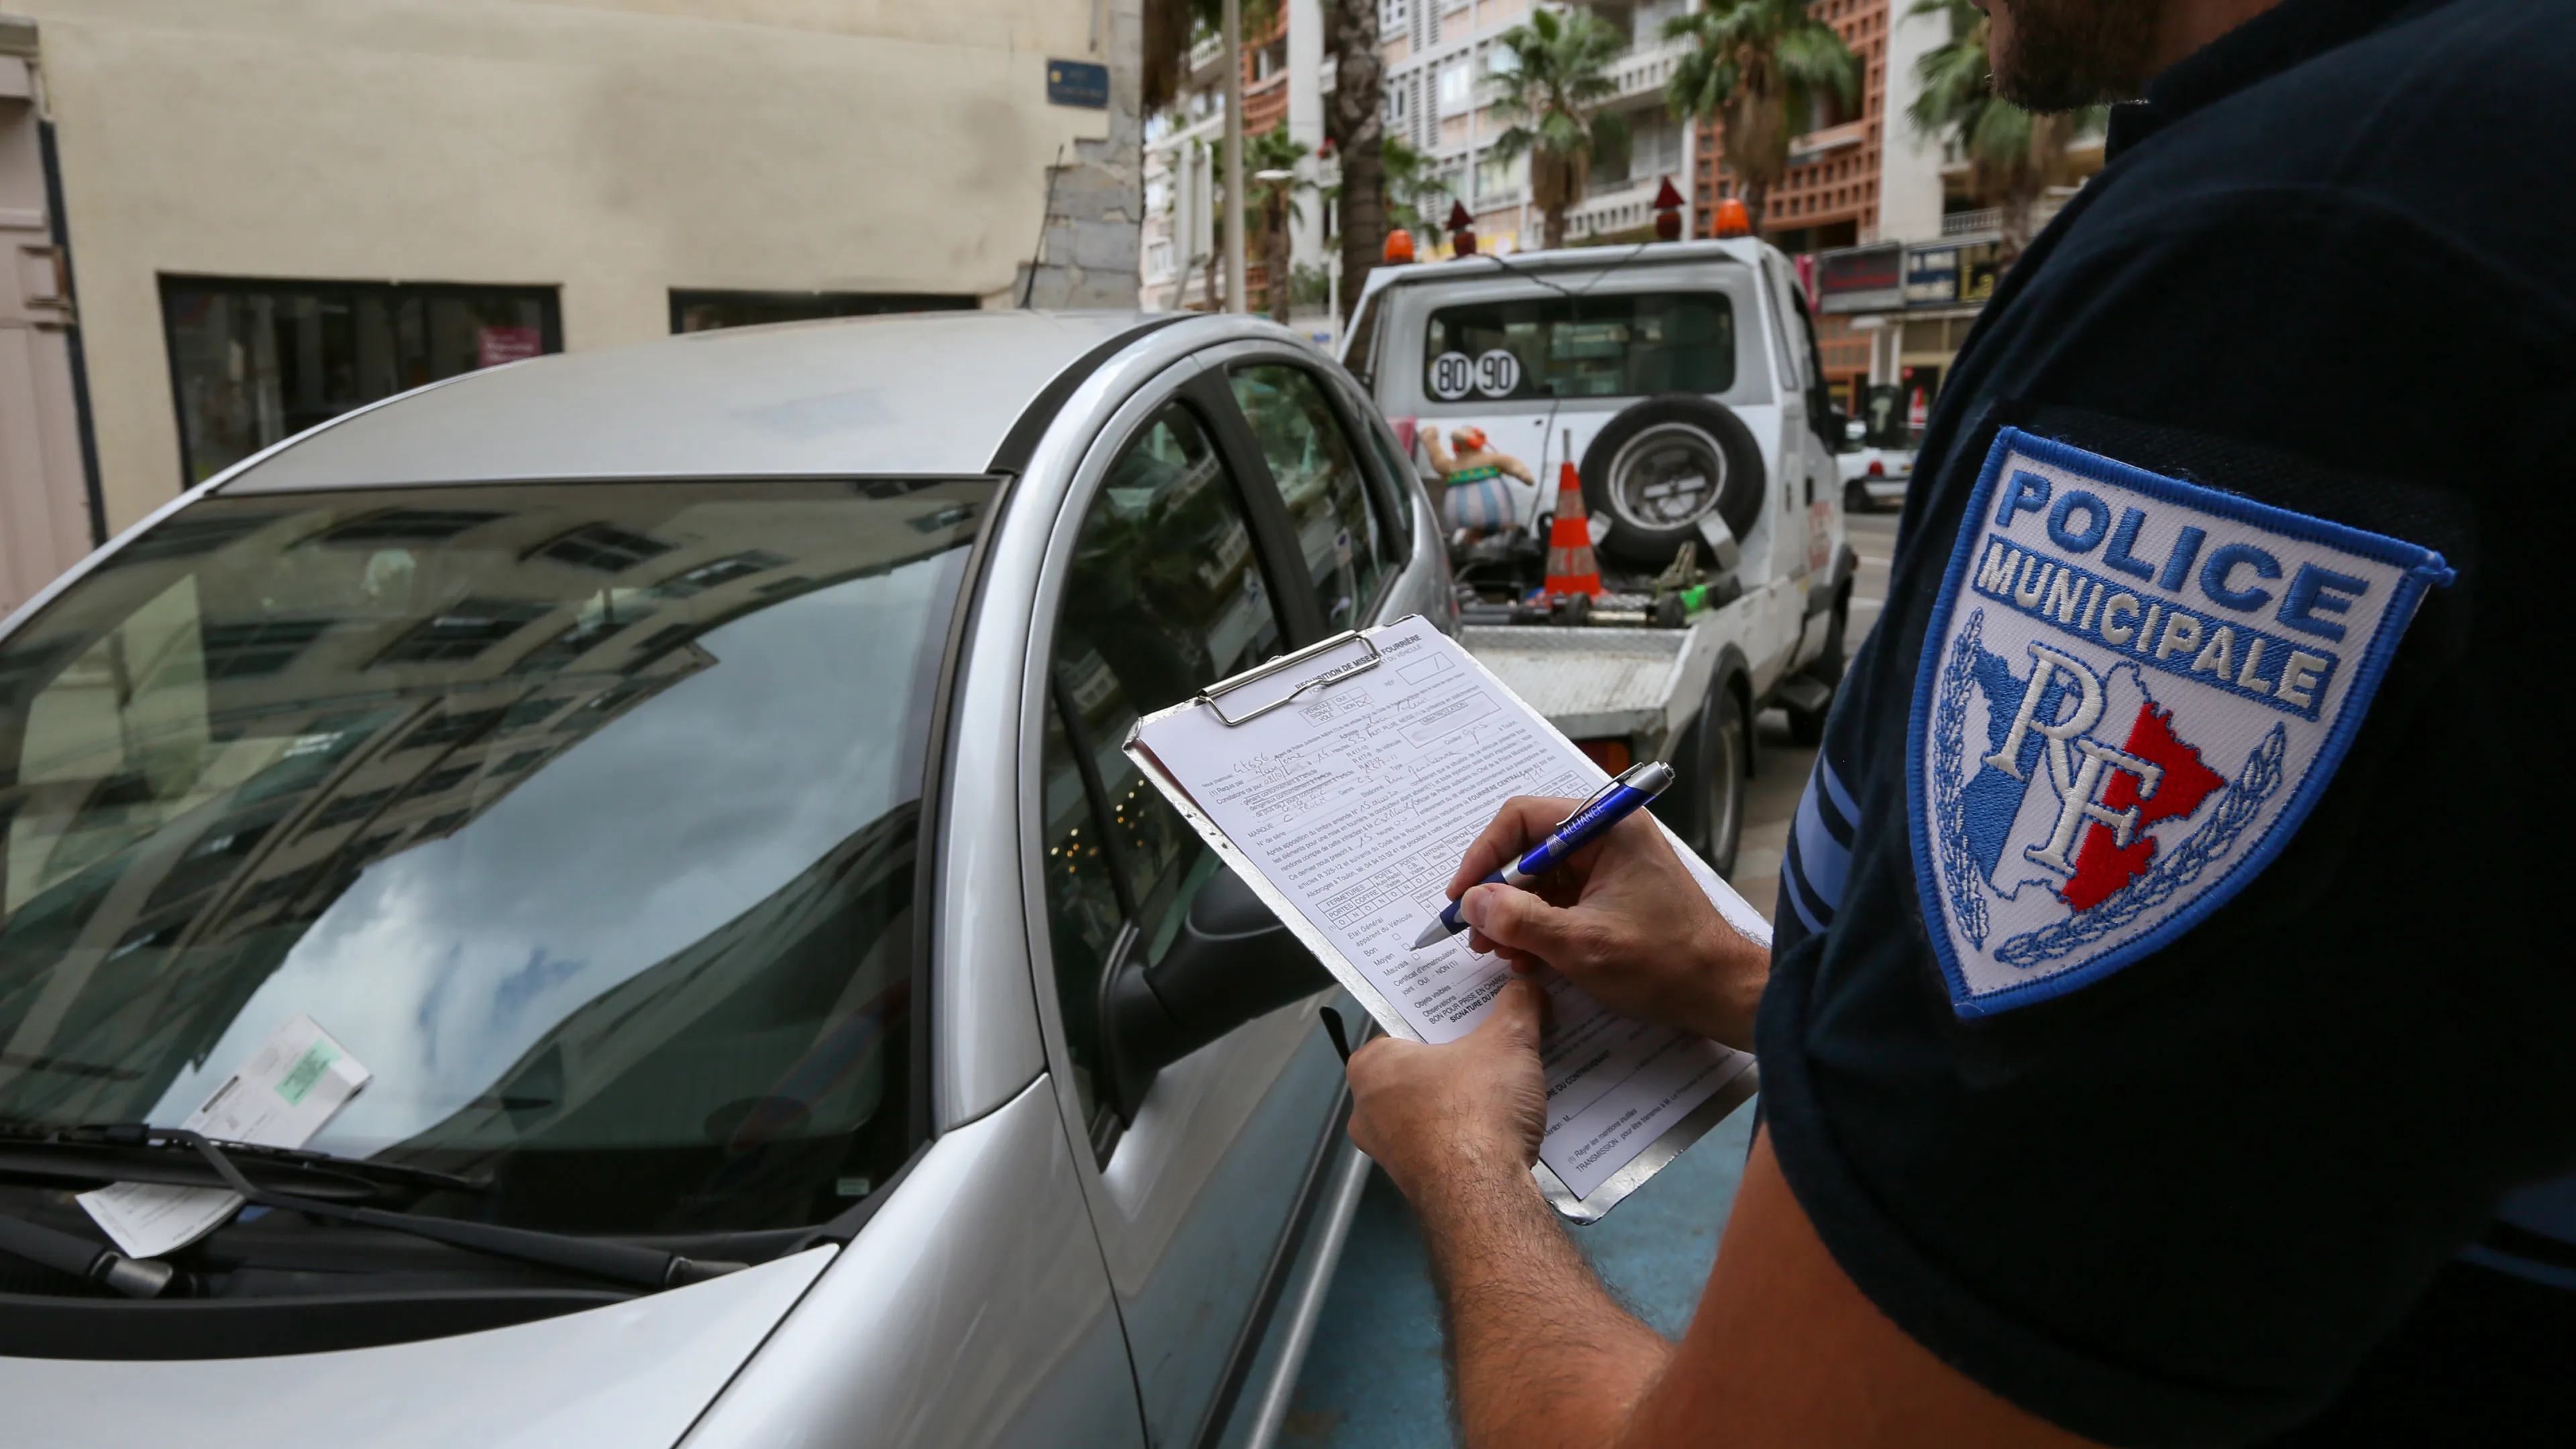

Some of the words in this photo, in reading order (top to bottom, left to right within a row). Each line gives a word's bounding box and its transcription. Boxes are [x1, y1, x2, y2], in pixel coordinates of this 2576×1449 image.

[1439, 358, 1467, 392] 80
[1483, 357, 1511, 390] 90
[1994, 470, 2372, 643] POLICE
[1978, 541, 2328, 710] MUNICIPALE
[1340, 662, 1354, 671] DE
[1352, 655, 1372, 667] MISE
[1379, 632, 1422, 655] FOURRIÈRE
[1342, 702, 1356, 710] NON
[1215, 788, 1246, 806] Constatons
[1250, 781, 1264, 791] jour
[1216, 782, 1236, 795] Requis
[1234, 778, 1245, 787] par
[1247, 822, 1275, 839] MARQUE
[1265, 845, 1283, 857] Après
[1281, 832, 1310, 850] apposition
[1330, 811, 1353, 825] amende
[1271, 829, 1287, 840] série
[1296, 875, 1319, 890] articles
[1322, 862, 1344, 877] 325-12
[1348, 848, 1373, 864] suivants
[1377, 837, 1394, 849] Code
[1404, 822, 1422, 835] Route
[1466, 782, 1499, 803] FOURRIÈRE
[1495, 769, 1525, 788] CENTRALE
[1563, 802, 1605, 838] ALLIANCE
[1271, 856, 1283, 864] les
[1280, 844, 1306, 860] éléments
[1304, 839, 1318, 849] pour
[1316, 834, 1329, 843] une
[1279, 857, 1303, 872] rendons
[1301, 848, 1323, 863] compte
[1327, 838, 1342, 849] cette
[1339, 826, 1364, 843] infraction
[1287, 872, 1299, 881] Ce
[1295, 863, 1318, 877] dernier
[1315, 857, 1330, 867] nous
[1328, 847, 1350, 861] prescrit
[1399, 855, 1417, 867] POSTE
[1421, 842, 1446, 858] ANTENNE
[1374, 867, 1393, 881] POSTE
[1305, 880, 1335, 900] Allobroges
[1325, 882, 1366, 908] FERMETURES
[1328, 902, 1354, 919] PORTES
[1354, 888, 1380, 906] COFFRE
[1346, 928, 1362, 940] Etat
[1359, 916, 1385, 933] Général
[1354, 929, 1382, 948] apparent
[1380, 925, 1390, 933] du
[1388, 911, 1413, 929] Véhicule
[1363, 945, 1379, 957] Bon
[1373, 951, 1396, 968] Moyen
[1392, 969, 1418, 987] Certificat
[1414, 945, 1458, 975] d'immatriculation
[1383, 958, 1409, 977] Mauvais
[1417, 976, 1430, 986] OUI
[1435, 964, 1450, 975] NON
[1447, 959, 1459, 969] (1)
[1413, 994, 1434, 1010] Objets
[1430, 983, 1452, 1000] visibles
[1428, 1012, 1444, 1025] BON
[1442, 1002, 1461, 1016] POUR
[1458, 991, 1478, 1006] PRISE
[1474, 987, 1486, 996] EN
[1483, 971, 1509, 991] CHARGE
[1448, 998, 1483, 1024] SIGNATURE
[1480, 993, 1492, 1003] DU
[1573, 1142, 1593, 1159] Rayer
[1589, 1136, 1600, 1146] les
[1597, 1120, 1621, 1140] mentions
[1618, 1106, 1638, 1124] inutiles
[1574, 1136, 1619, 1174] TRANSMISSION
[1618, 1126, 1634, 1140] pour
[1629, 1118, 1643, 1130] être
